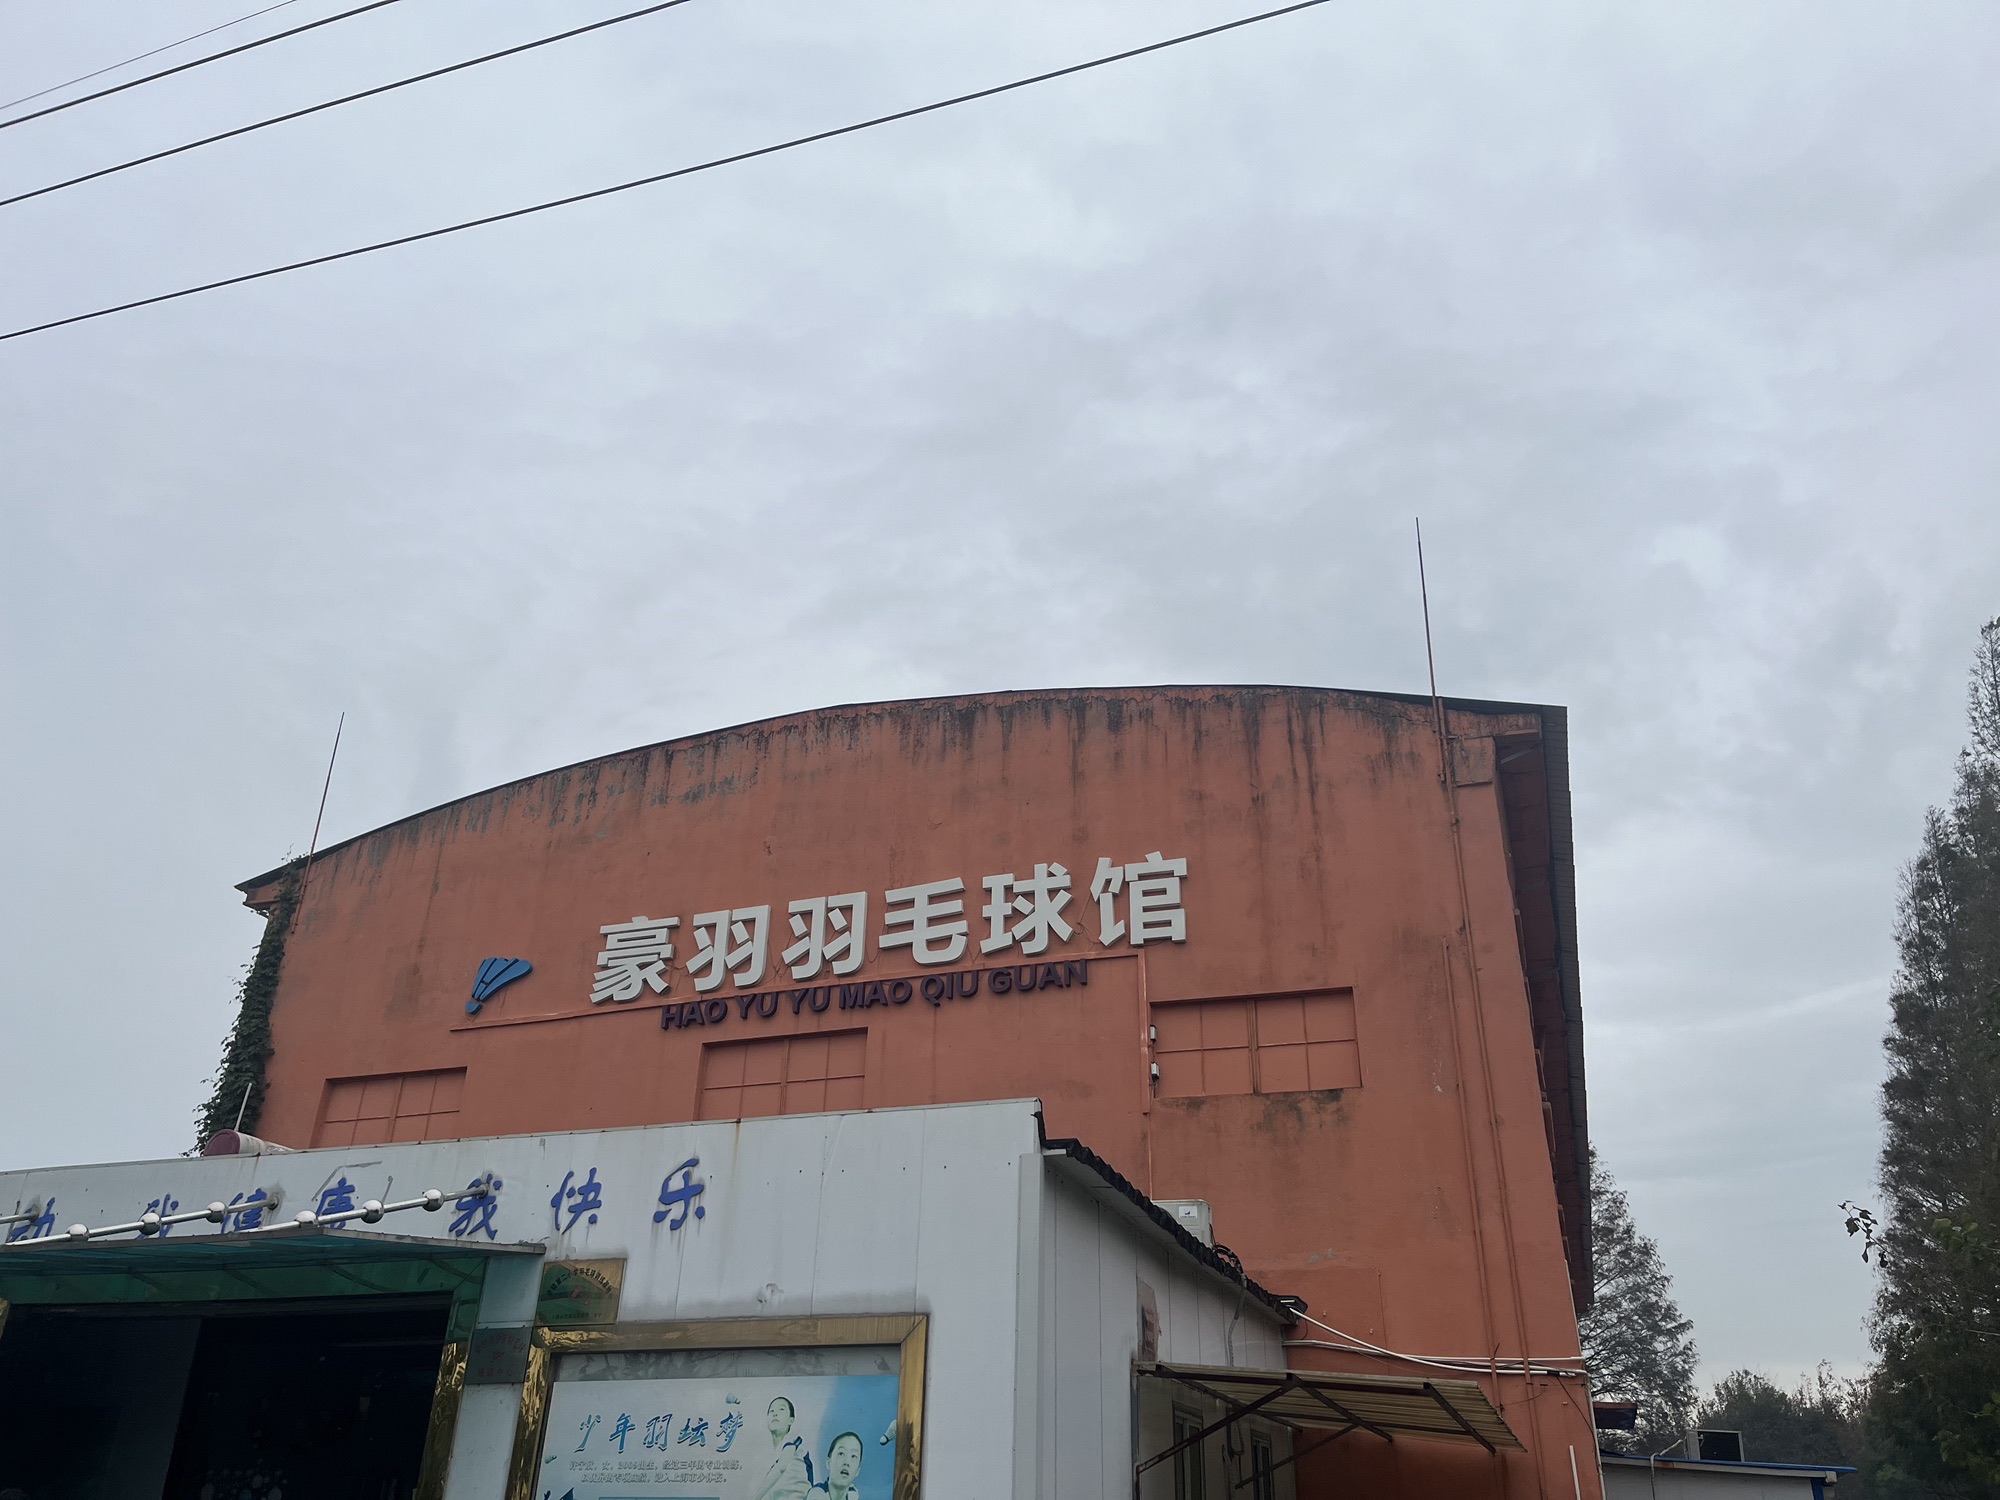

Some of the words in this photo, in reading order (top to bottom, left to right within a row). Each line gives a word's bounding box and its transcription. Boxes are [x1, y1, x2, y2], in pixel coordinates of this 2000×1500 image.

[589, 850, 1189, 1005] 豪羽羽毛球馆
[660, 998, 728, 1029] HAO
[736, 991, 778, 1019] YU
[785, 985, 832, 1014] YU
[838, 977, 913, 1010] MAO
[919, 969, 980, 1007] QIU
[986, 957, 1089, 996] GUAN
[574, 1411, 744, 1453] 少年羽坛梦
